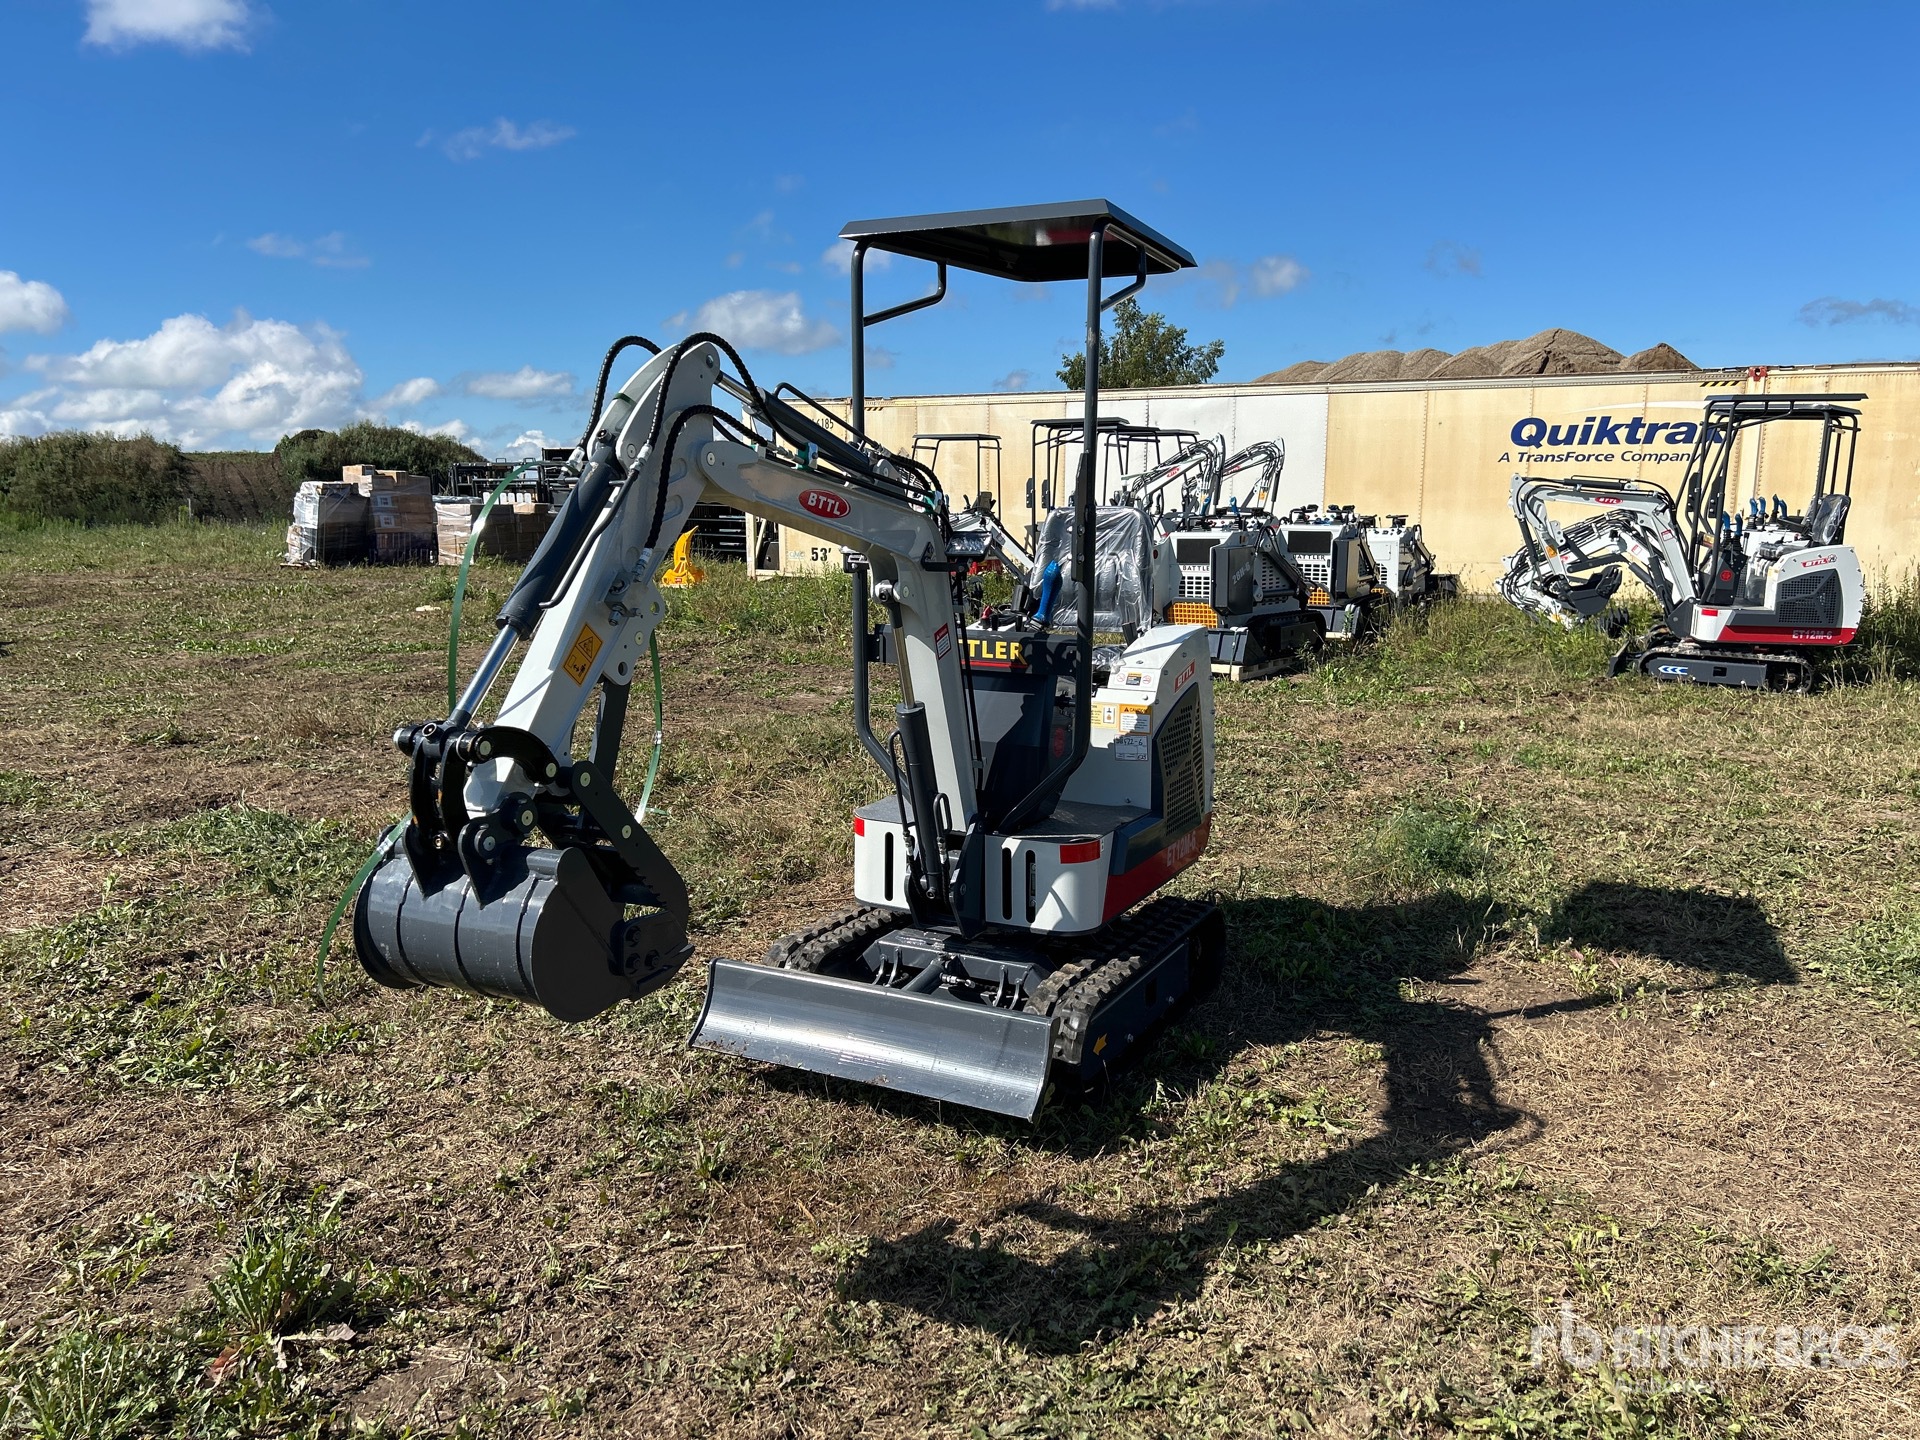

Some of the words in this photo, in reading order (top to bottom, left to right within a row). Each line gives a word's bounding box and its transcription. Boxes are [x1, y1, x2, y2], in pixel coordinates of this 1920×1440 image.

[1498, 452, 1511, 463] A
[1517, 451, 1615, 464] TransForce
[807, 492, 841, 516] BTTL
[811, 547, 832, 561] 53'
[1792, 629, 1833, 640] ET12M-6
[958, 639, 1028, 665] TLER
[1176, 665, 1193, 687] BTTL
